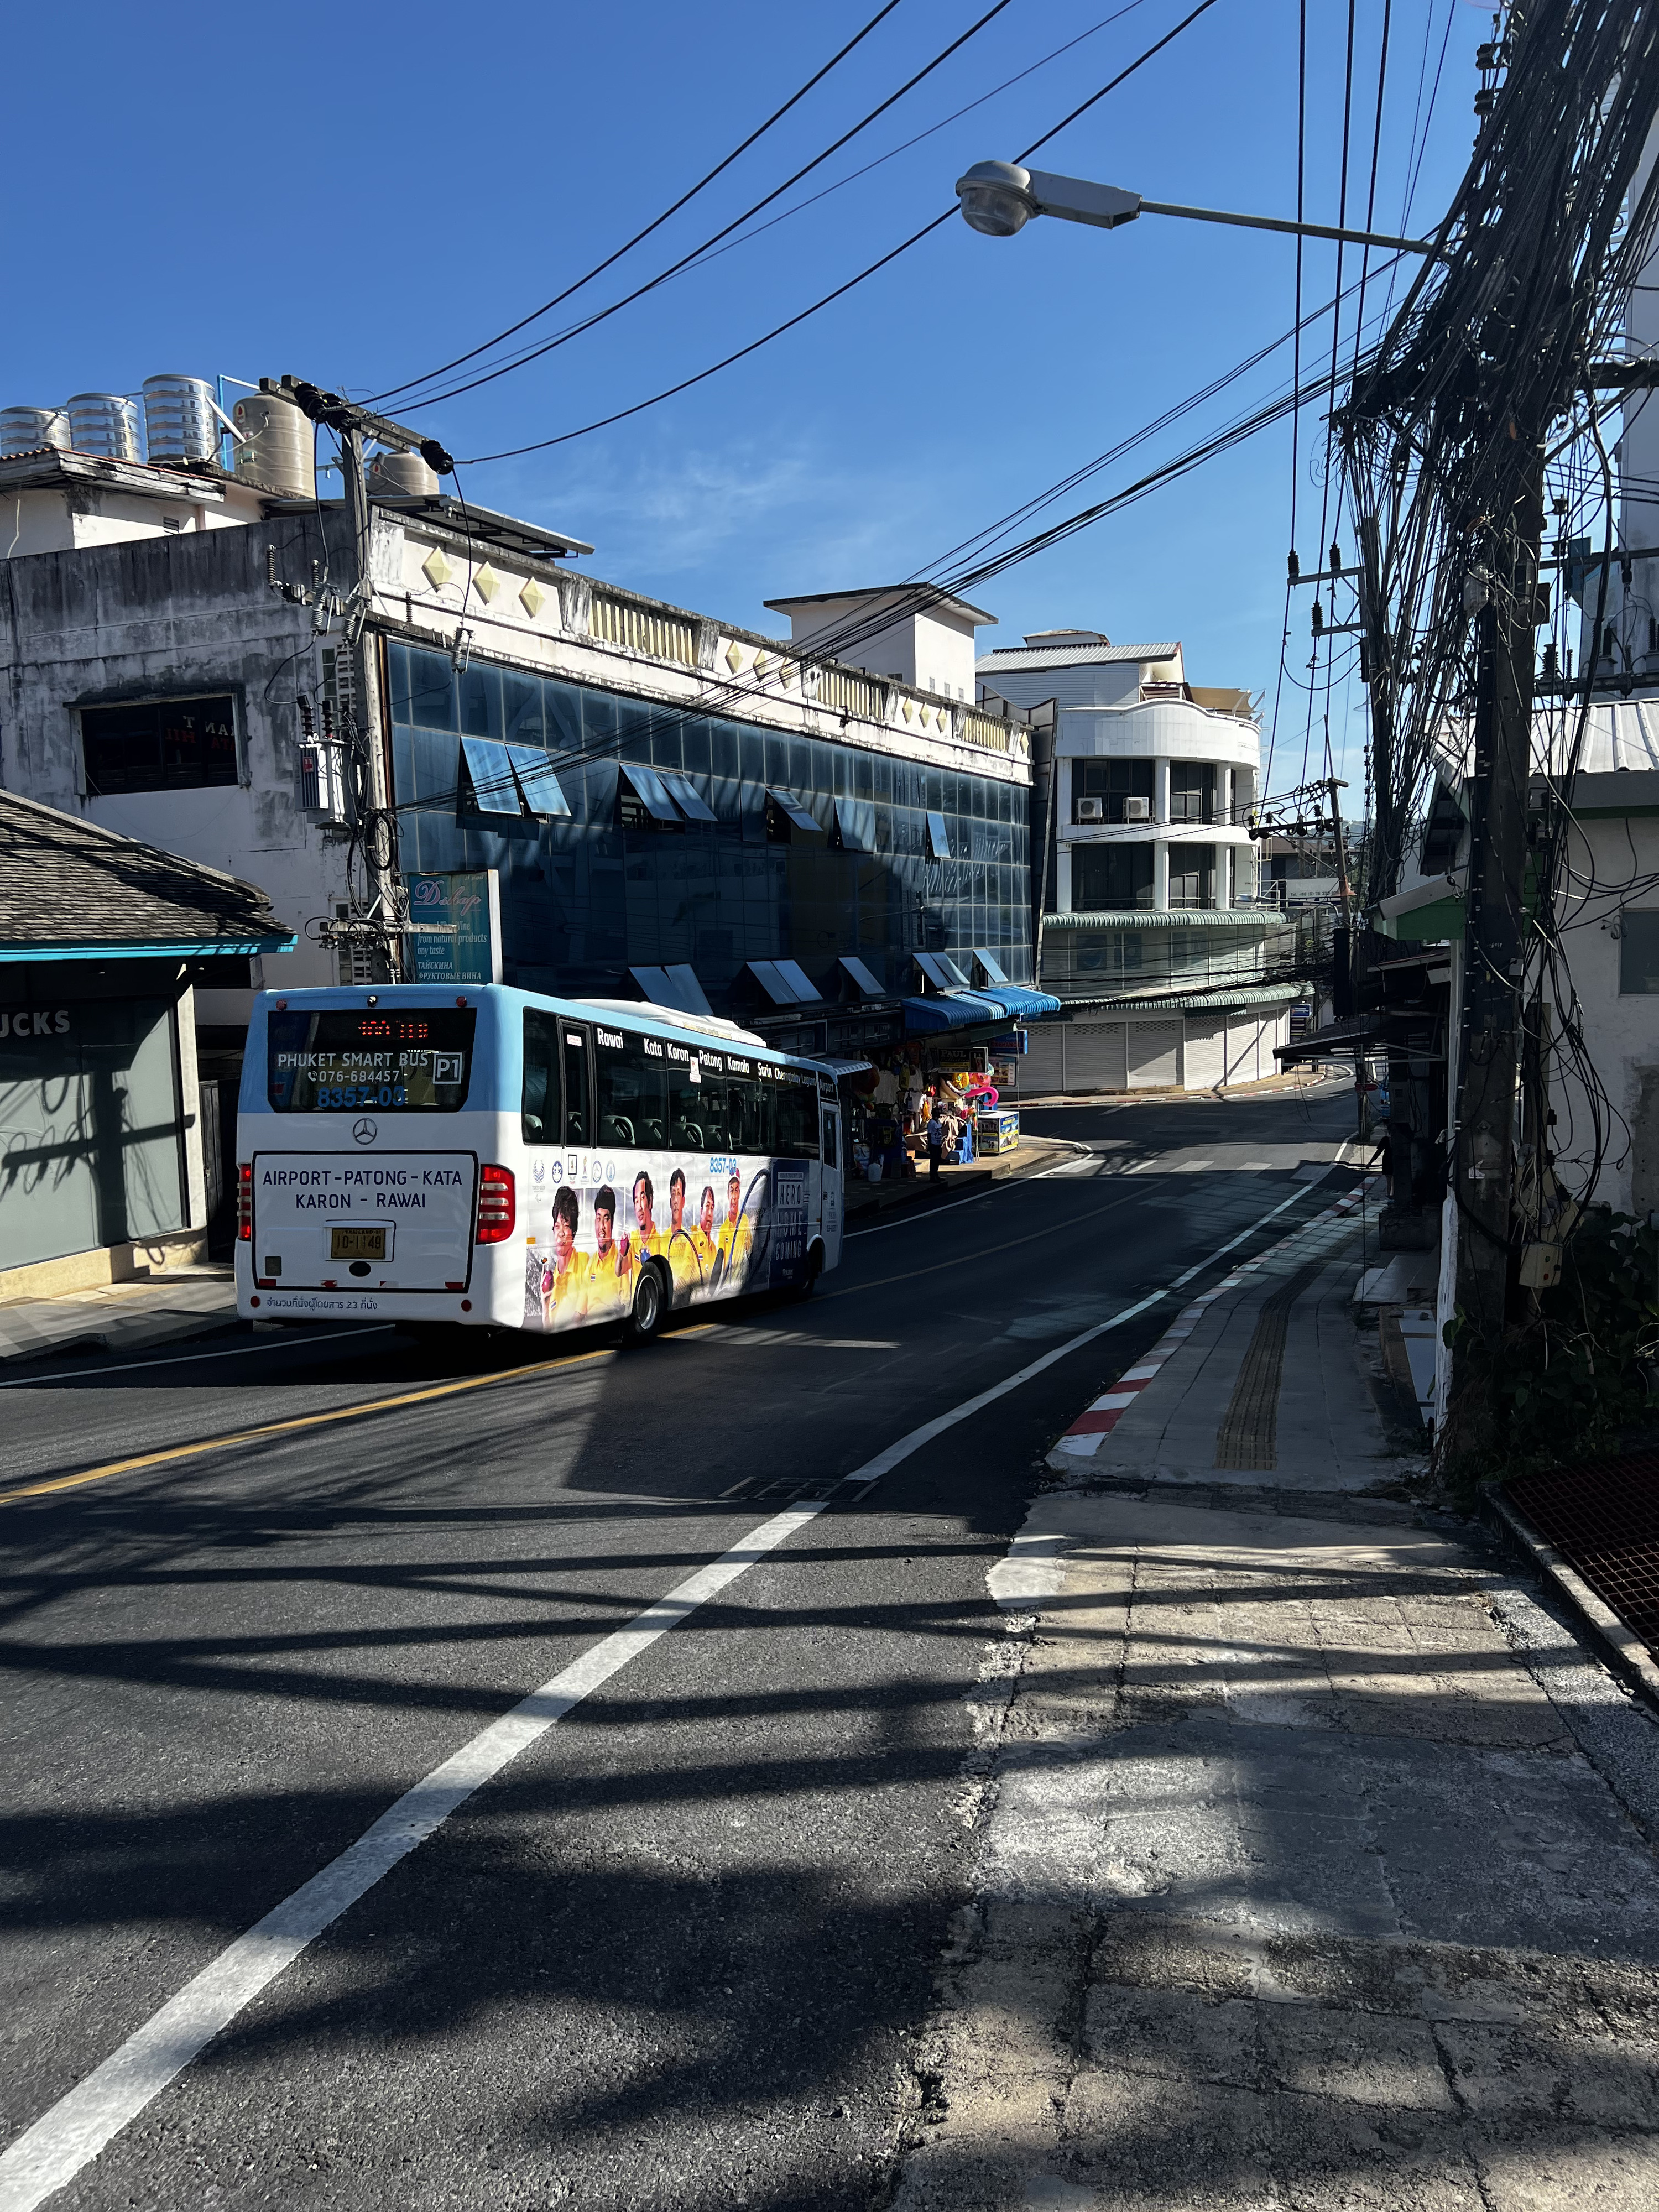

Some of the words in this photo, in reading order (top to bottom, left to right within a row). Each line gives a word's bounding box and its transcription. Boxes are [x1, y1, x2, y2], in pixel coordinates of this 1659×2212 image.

[413, 880, 482, 916] Dshop
[417, 933, 432, 946] from
[433, 934, 457, 943] natural
[458, 932, 487, 946] products
[417, 947, 429, 958] any
[429, 946, 445, 955] taste
[462, 972, 482, 980] ВИНА
[597, 1027, 624, 1049] Rawai
[644, 1037, 662, 1057] Kata
[667, 1042, 689, 1062] Karon
[699, 1050, 723, 1072] Patong
[727, 1055, 750, 1074] Kamala
[757, 1062, 773, 1078] Surin
[278, 1053, 336, 1067] PHUKET
[341, 1053, 392, 1067] SMART
[398, 1052, 428, 1068] BUS
[436, 1058, 459, 1078] P1
[319, 1071, 399, 1082] 076-684457
[317, 1086, 405, 1108] 8357-03
[709, 1157, 737, 1173] 8357-03
[263, 1171, 331, 1185] AIRPORT
[344, 1170, 407, 1185] PATONG
[422, 1170, 462, 1185] KATA
[296, 1194, 351, 1208] KARON
[376, 1193, 425, 1208] RAWAI
[780, 1185, 800, 1205] HERO
[776, 1240, 801, 1260] COMING
[361, 1298, 378, 1310] ที่นั่ง
